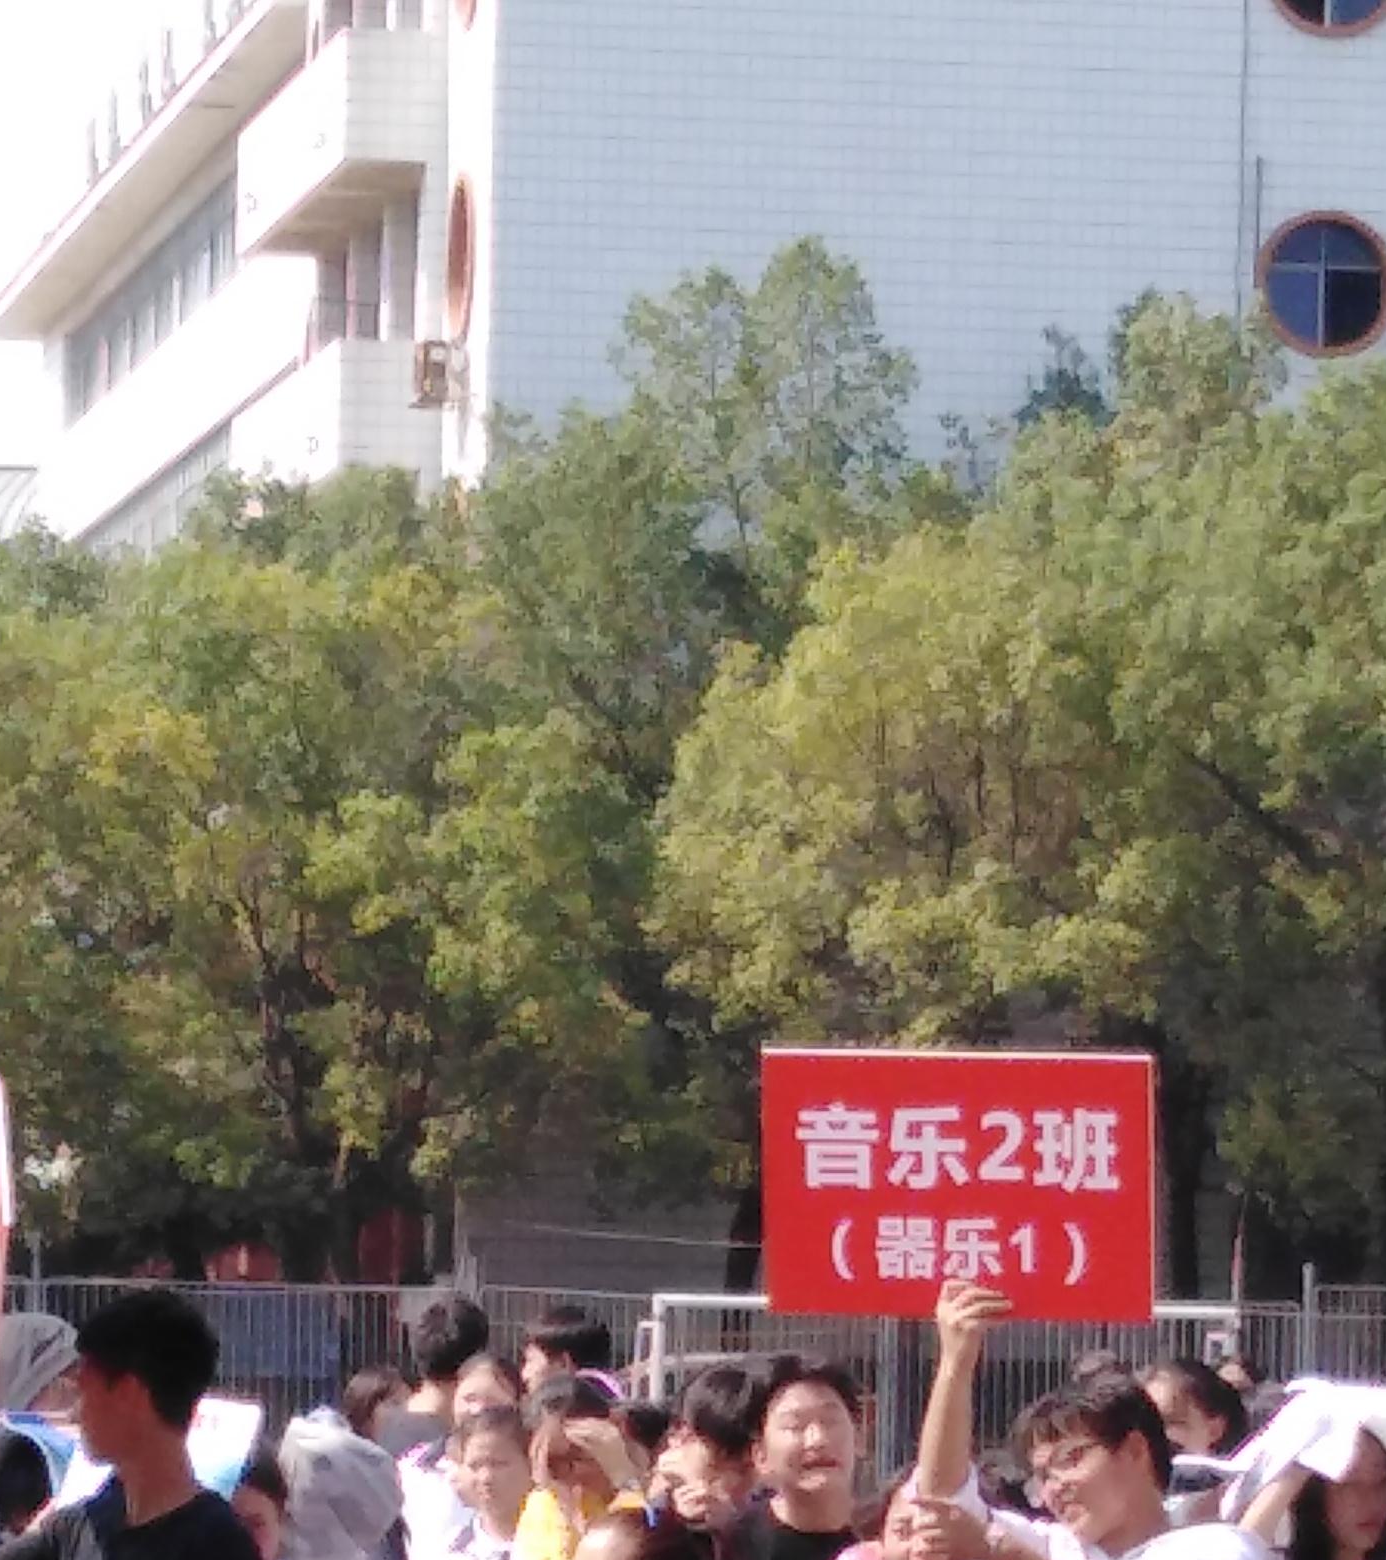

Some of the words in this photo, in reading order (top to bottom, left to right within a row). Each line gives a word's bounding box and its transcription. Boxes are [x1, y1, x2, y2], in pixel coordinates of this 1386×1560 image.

[796, 1102, 1120, 1193] 音乐2班
[830, 1215, 1088, 1287] （器乐1）
